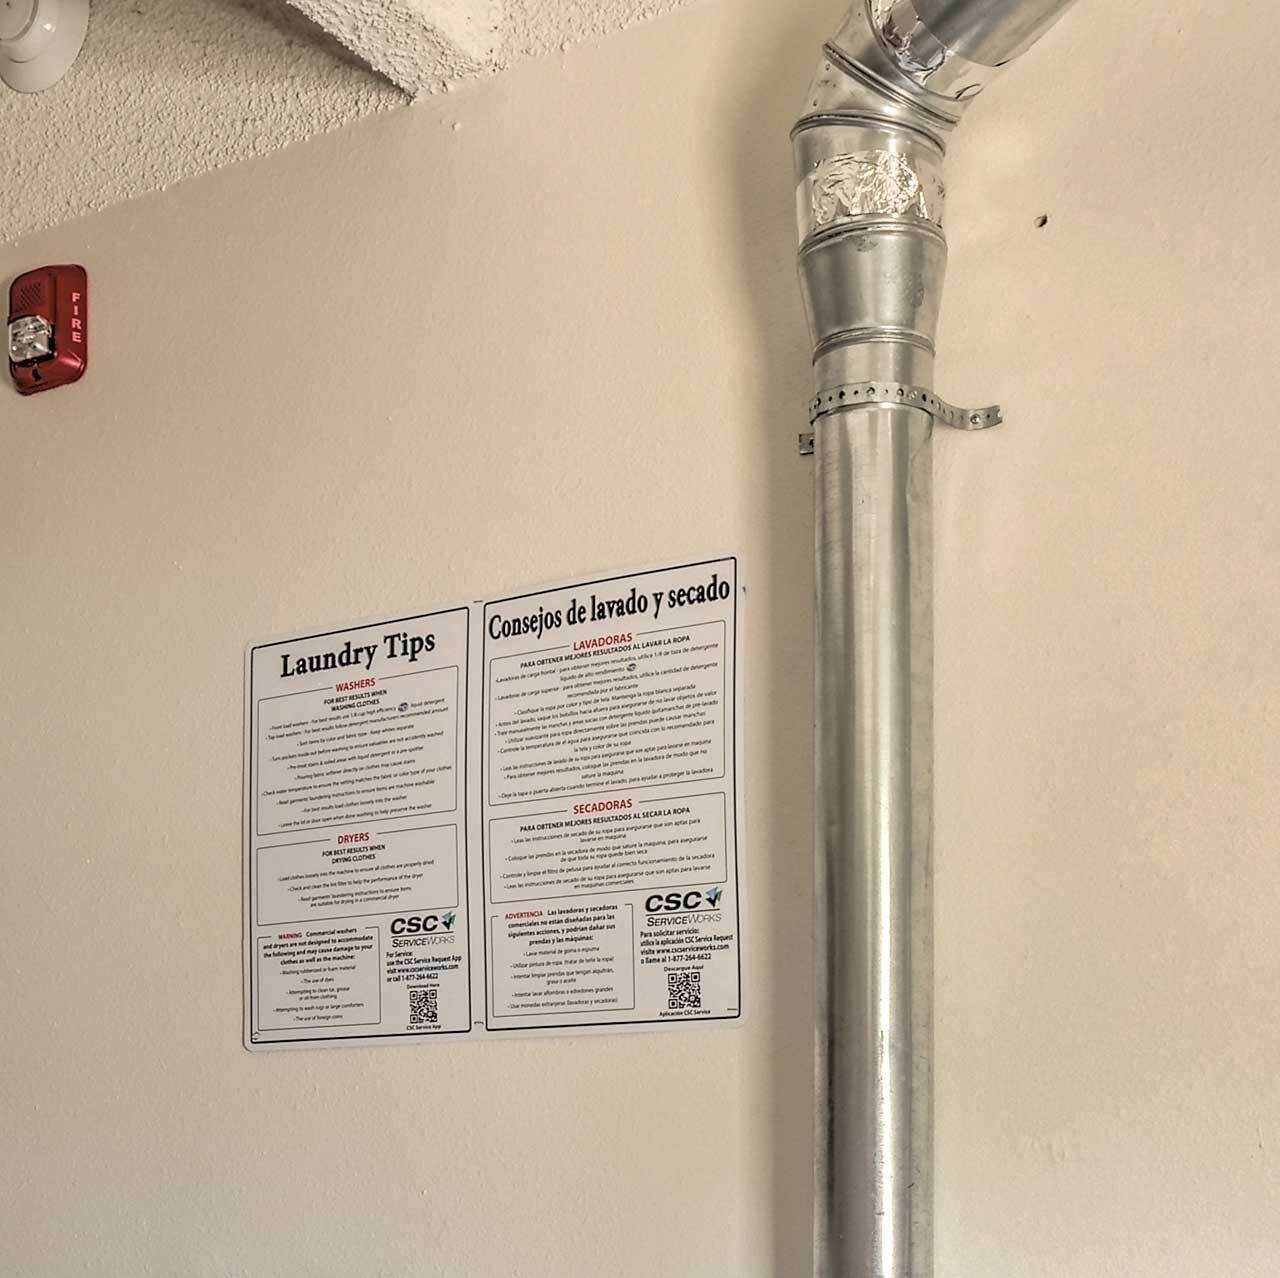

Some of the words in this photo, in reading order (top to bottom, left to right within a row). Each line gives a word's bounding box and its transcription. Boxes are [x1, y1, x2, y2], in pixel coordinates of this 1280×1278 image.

[72, 292, 82, 343] FIRE
[489, 606, 562, 640] Consejos
[567, 599, 587, 626] de
[590, 588, 648, 622] lavado
[653, 591, 664, 619] y
[667, 574, 730, 609] secado
[573, 632, 633, 651] LAVADORAS
[280, 641, 378, 678] Laundry
[383, 632, 436, 662] Tips
[520, 660, 536, 669] PARA
[536, 656, 564, 666] OBTENER
[564, 651, 592, 661] MEJORES
[592, 644, 632, 656] RESULTADOS
[641, 639, 662, 649] LAVAR
[663, 638, 672, 646] LA
[672, 635, 691, 643] ROPA
[335, 677, 376, 693] WASHERS
[335, 695, 348, 703] BEST
[348, 692, 371, 701] RESULTS
[371, 689, 388, 697] WHEN
[331, 702, 356, 712] WASHING
[356, 698, 380, 708] CLOTHES
[573, 799, 633, 815] SECADORAS
[536, 821, 564, 831] OBTENER
[564, 818, 592, 827] MEJORES
[592, 813, 632, 824] RESULTADOS
[632, 812, 641, 820] AL
[642, 810, 663, 819] SECAR
[672, 807, 691, 815] ROPA
[337, 832, 370, 844] DRYERS
[333, 848, 346, 856] BEST
[346, 846, 369, 854] RESULTS
[331, 856, 352, 864] DRYING
[352, 853, 376, 862] CLOTHES
[645, 891, 702, 912] CSC
[504, 910, 543, 920] ADVERTENCIA
[557, 907, 585, 915] lavadoras
[390, 915, 439, 934] CSC
[507, 920, 540, 929] comerciales
[592, 915, 606, 923] para
[646, 914, 722, 927] SERVICEWORKS
[305, 929, 336, 938] Commercial
[508, 931, 536, 939] siguientes
[392, 935, 455, 948] SERVICEWORKS
[528, 938, 552, 947] prendas
[640, 939, 655, 947] utilice
[655, 938, 660, 946] la
[684, 935, 695, 944] CSC
[694, 935, 713, 943] Service
[713, 934, 734, 942] Request
[640, 948, 655, 956] visite
[661, 955, 667, 963] al
[668, 953, 712, 962] 1-877-264-6622
[401, 972, 439, 981] 1-877-264-6622
